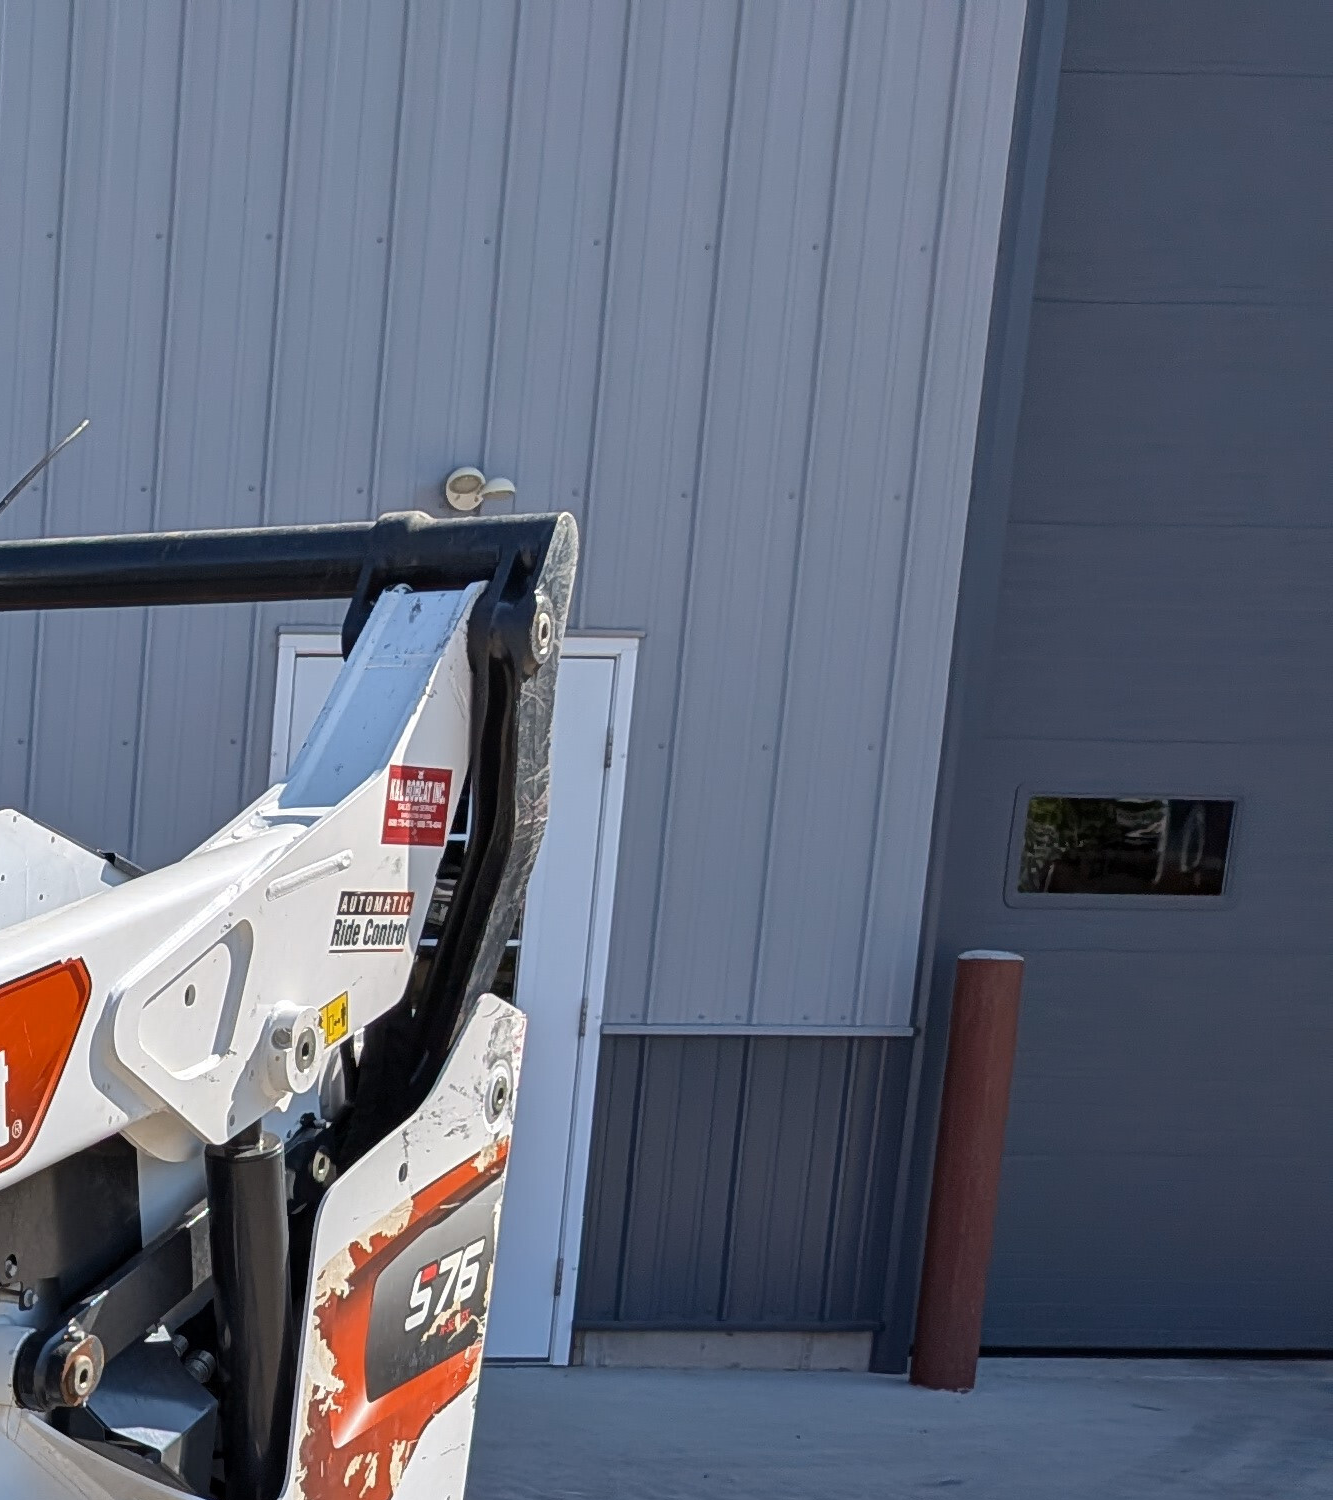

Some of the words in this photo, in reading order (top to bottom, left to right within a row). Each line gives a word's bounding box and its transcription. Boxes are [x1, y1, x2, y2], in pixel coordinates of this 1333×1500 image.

[339, 894, 412, 914] AUTOMATIC
[330, 918, 360, 946] Ride
[363, 917, 410, 946] Control
[404, 1236, 486, 1332] S76
